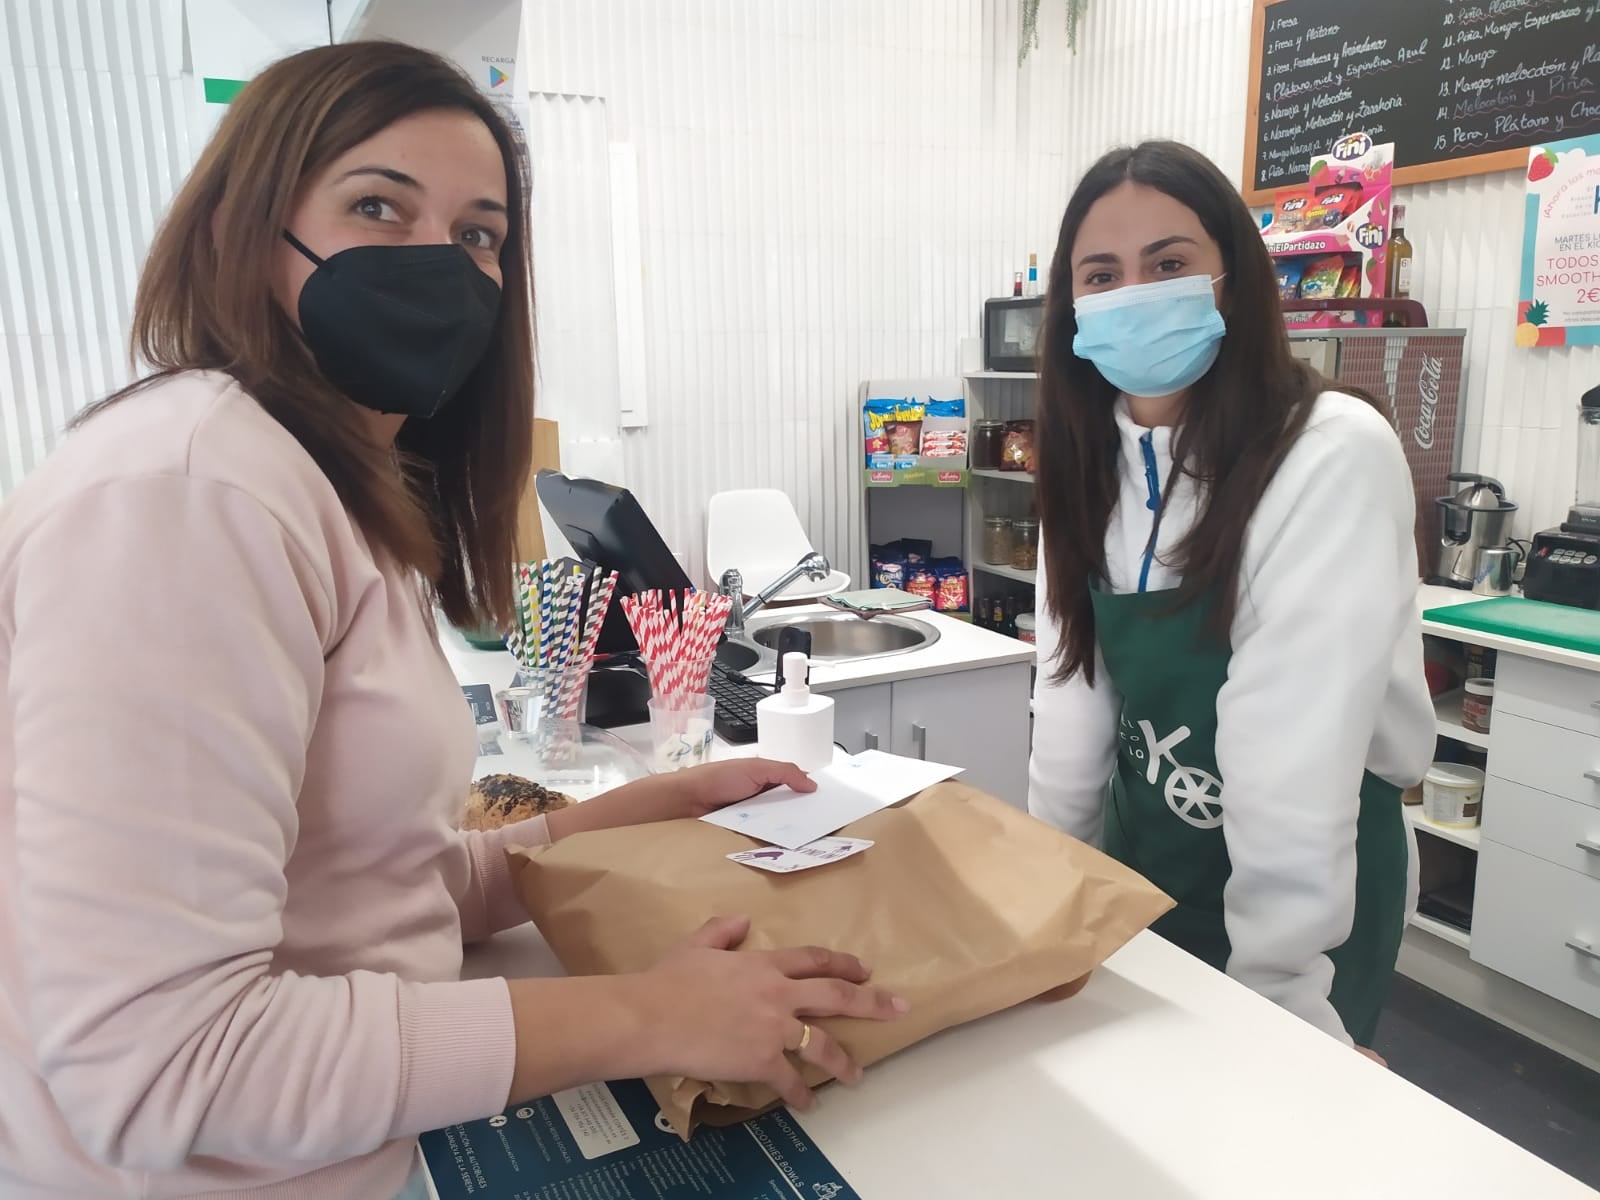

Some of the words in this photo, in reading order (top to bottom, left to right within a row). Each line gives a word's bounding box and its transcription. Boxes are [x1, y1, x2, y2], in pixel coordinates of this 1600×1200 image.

[481, 56, 515, 64] RECARGA
[1313, 72, 1333, 87] miel
[1397, 38, 1428, 62] Azul
[1458, 48, 1497, 69] Mango
[1453, 127, 1489, 143] Pera,
[1495, 113, 1549, 135] Plátano
[1555, 115, 1564, 132] y
[1554, 233, 1591, 244] MARTES
[1559, 243, 1571, 252] EN
[1574, 242, 1584, 250] EL
[1546, 254, 1599, 270] TODOS
[1577, 287, 1600, 304] 2€
[774, 1111, 807, 1152] SMOOTHIES
[748, 1119, 784, 1161] SMOOTHIES
[779, 1160, 805, 1188] BOWLS
